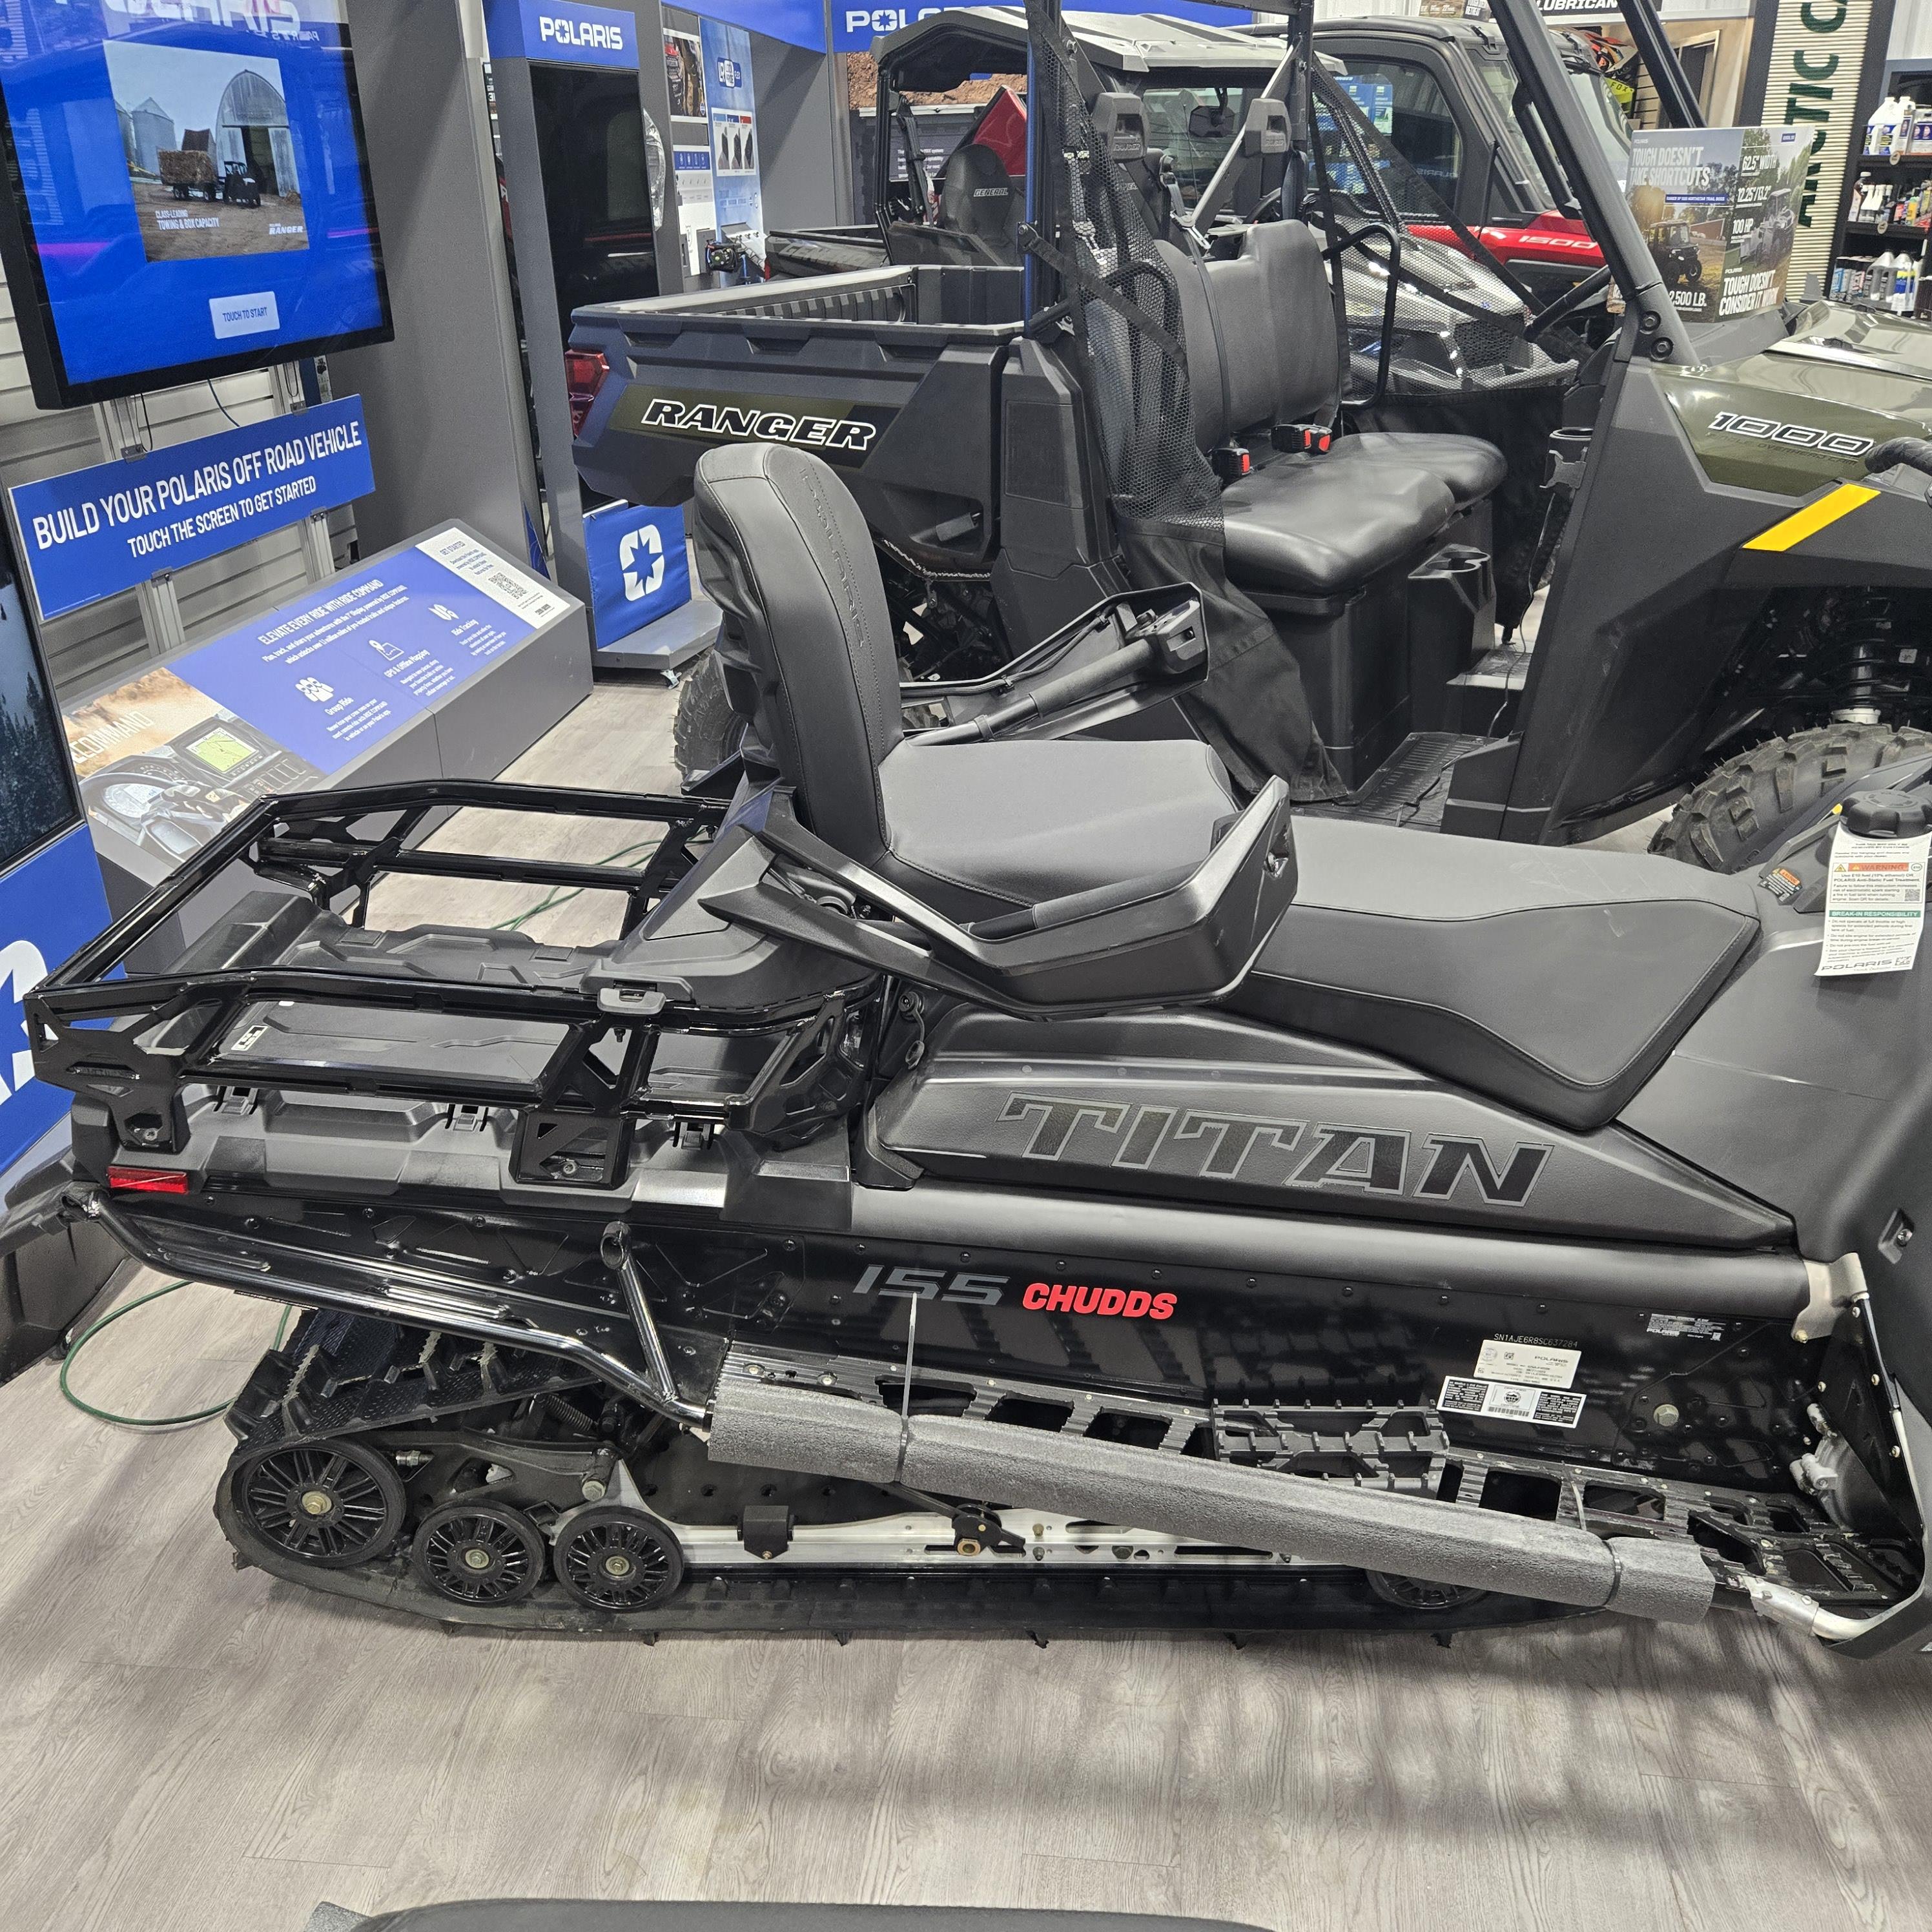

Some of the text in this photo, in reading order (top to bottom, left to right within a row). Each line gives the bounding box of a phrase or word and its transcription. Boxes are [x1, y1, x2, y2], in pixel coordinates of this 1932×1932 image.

[539, 15, 623, 50] POLARIS
[1610, 81, 1629, 92] FOX
[1632, 147, 1704, 166] TOUGH DOESN'T
[1760, 154, 1777, 170] WIDTH
[1629, 167, 1711, 187] TAKE SHORTCUTS
[973, 187, 1009, 197] GENERAL
[155, 209, 189, 219] CLASS-LEADING
[157, 220, 180, 231] TOWING
[184, 218, 196, 229] BOX
[194, 217, 220, 228] CAPACITY
[269, 226, 303, 235] RANGER
[1732, 218, 1754, 234] 100 HP
[1518, 235, 1598, 249] 1500
[1723, 270, 1776, 296] TOUGH DOESN'T
[1693, 291, 1707, 307] LB.
[1719, 293, 1757, 316] CONSIDER
[1756, 291, 1763, 309] IT
[222, 307, 268, 322] TOUCH TO START
[641, 398, 876, 451] RANGER
[1707, 411, 1875, 456] 1000
[33, 421, 362, 550] BUILD YOUR POLARIS OFF ROAD VEHICLE
[127, 475, 316, 558] TOUCH THE SCREEN TO GET STARTED
[258, 579, 384, 644] ELEVATE EVERY RIDE WITH RIDE COMMAND
[451, 627, 464, 635] Ride
[458, 619, 478, 631] Tracking
[324, 697, 354, 715] Group Ride
[69, 711, 154, 758] COMMAND
[1821, 960, 1893, 971] POLARIS
[995, 1091, 1555, 1207] TITAN
[854, 1264, 1009, 1306] 155
[1022, 1282, 1178, 1320] CHUDDS
